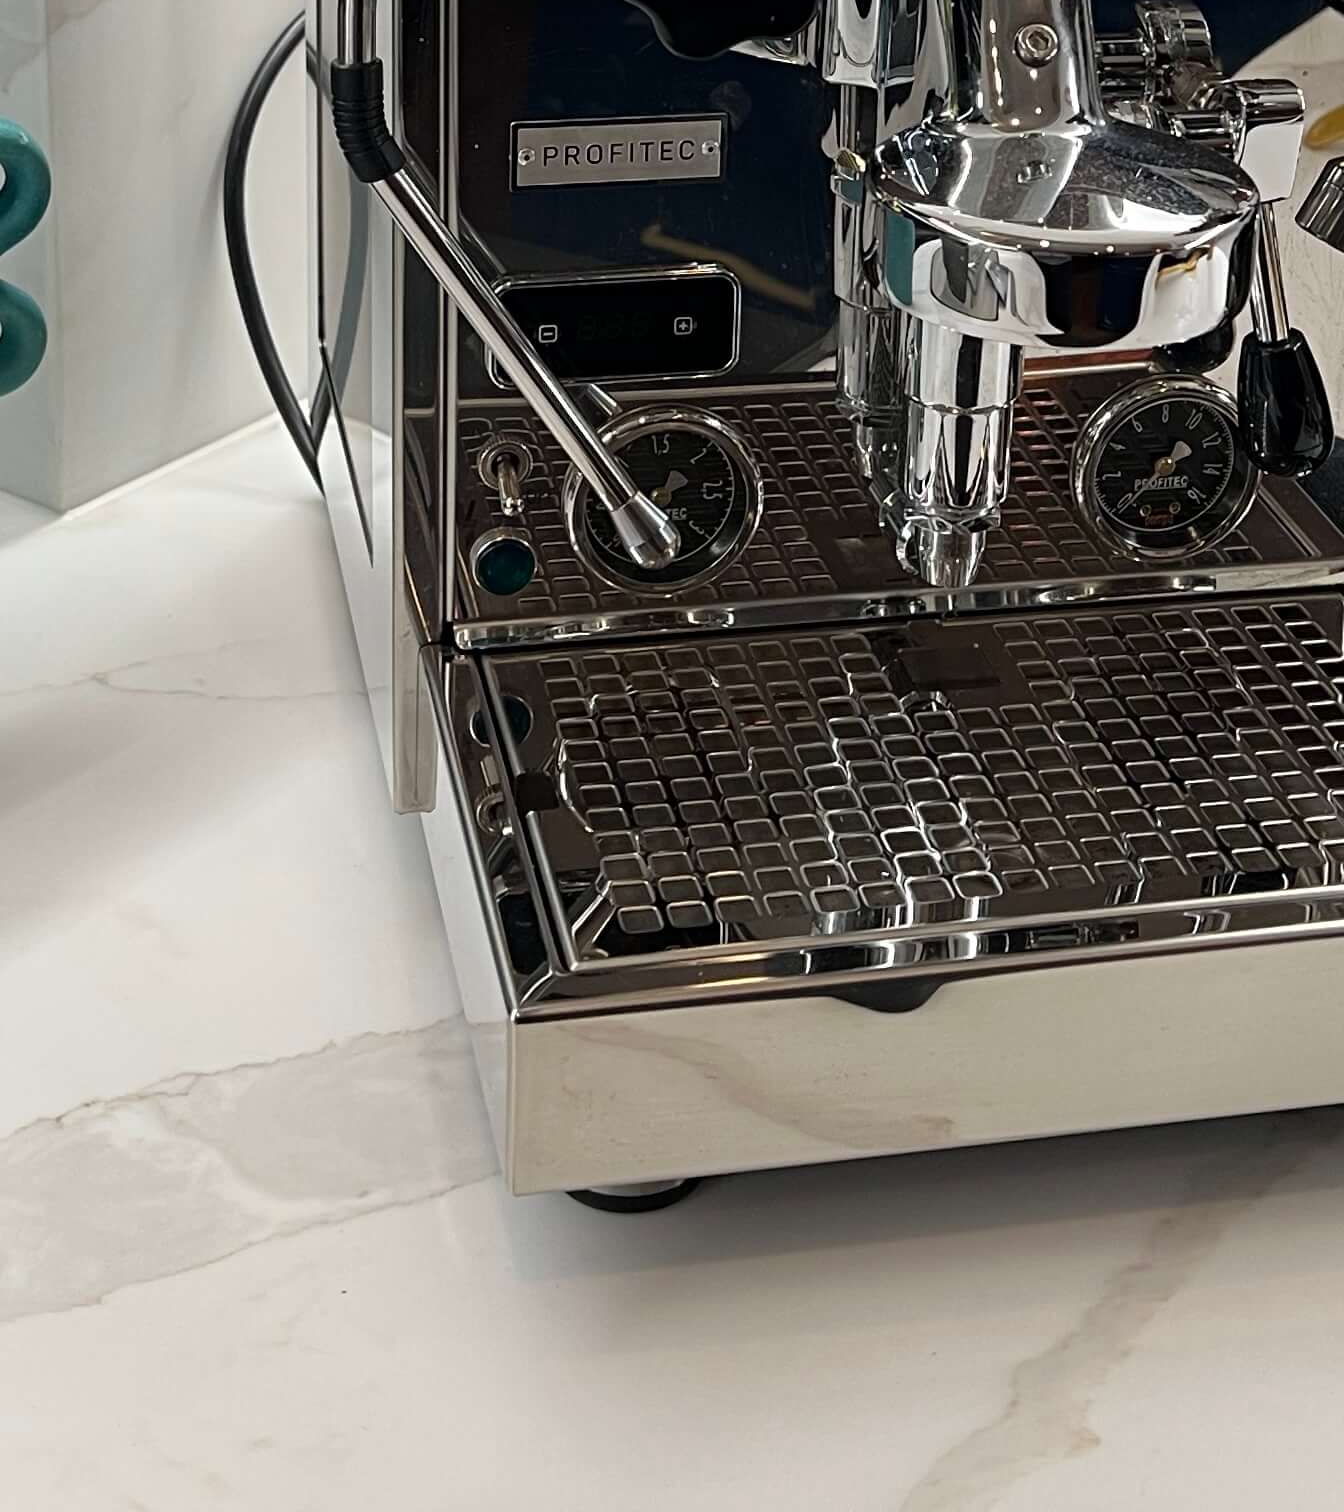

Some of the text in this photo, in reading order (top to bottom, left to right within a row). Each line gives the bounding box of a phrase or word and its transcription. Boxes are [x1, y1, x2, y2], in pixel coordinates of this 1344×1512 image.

[542, 139, 697, 167] PROFITEC
[1161, 404, 1170, 424] 8
[1185, 409, 1203, 429] 10
[1131, 417, 1143, 433] 6
[1108, 441, 1127, 451] 4
[1202, 431, 1222, 449] 12
[690, 447, 707, 465] 2
[1102, 470, 1122, 481] 2
[1202, 463, 1223, 476] 14
[1187, 486, 1207, 505] 16
[688, 519, 706, 536] 3
